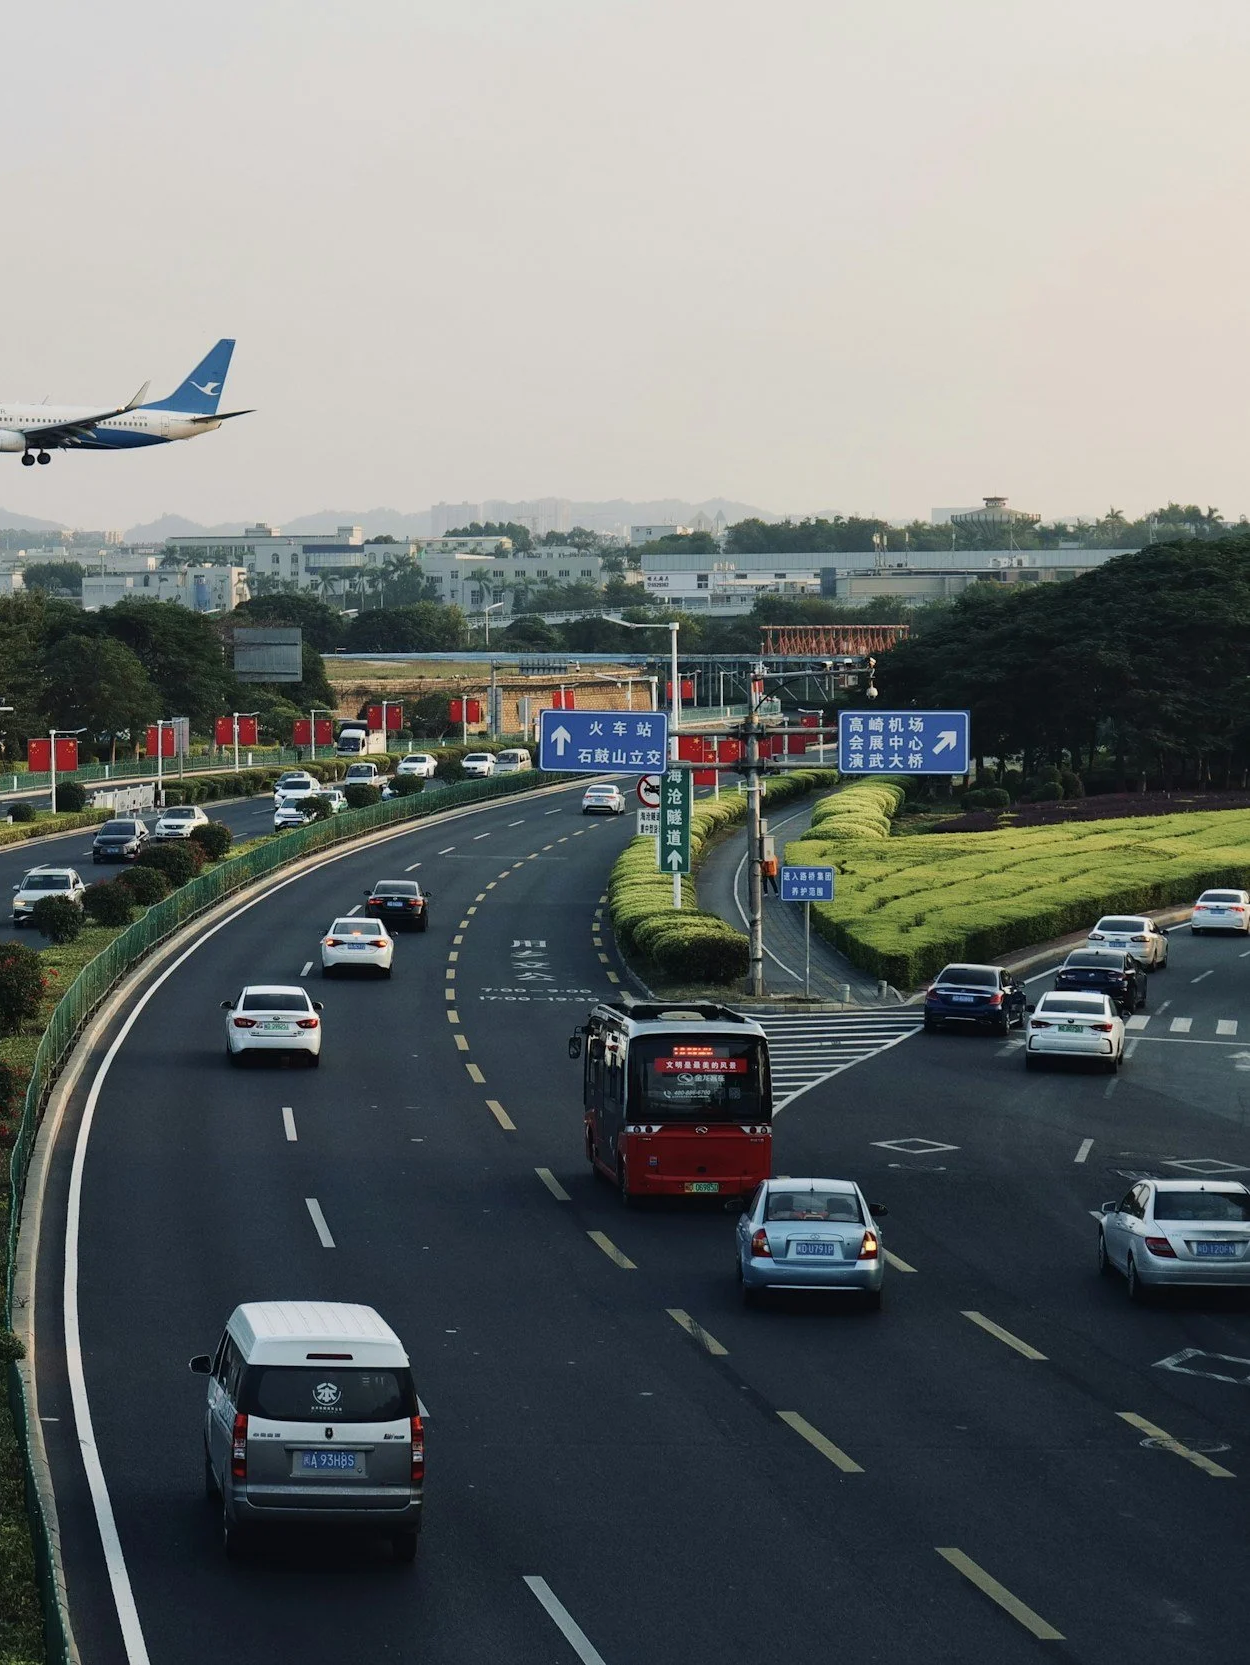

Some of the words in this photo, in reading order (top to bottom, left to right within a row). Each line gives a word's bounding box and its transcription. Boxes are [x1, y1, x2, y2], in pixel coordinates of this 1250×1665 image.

[589, 720, 653, 737] 火车站
[848, 717, 924, 732] 高崎机场
[848, 735, 924, 751] 会展中心
[577, 748, 662, 766] 石鼓山立交
[848, 753, 924, 769] 演武大桥
[666, 769, 683, 846] 海沧隧道
